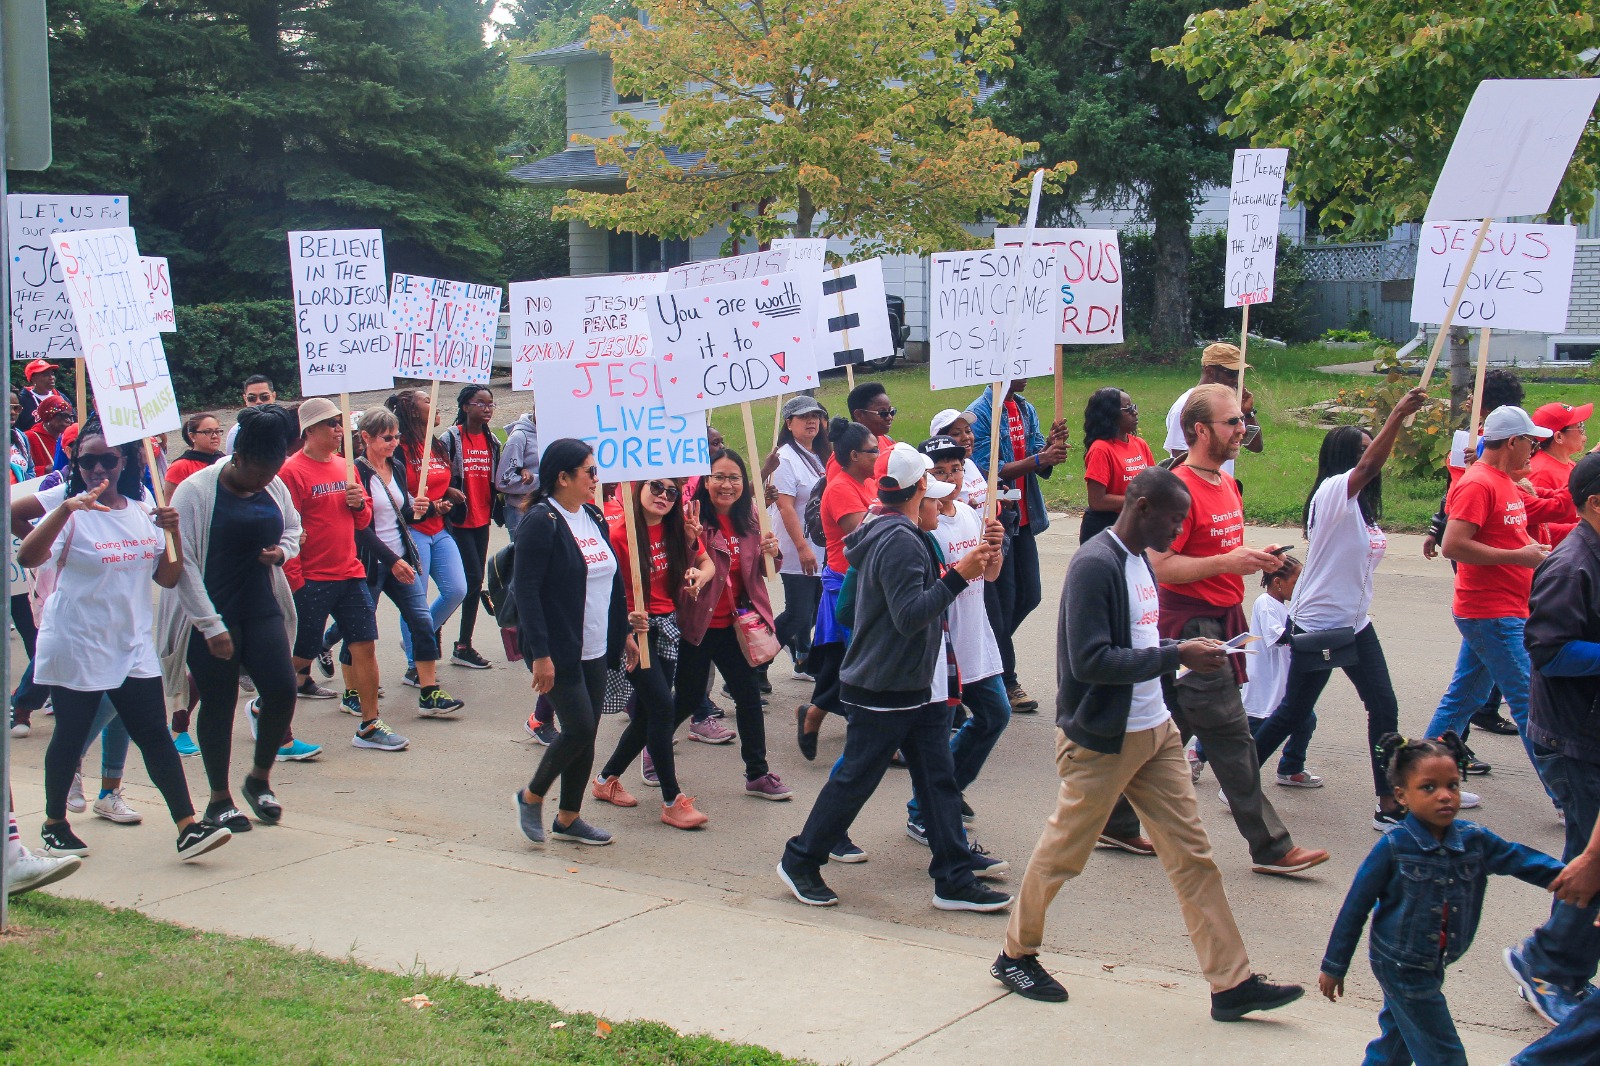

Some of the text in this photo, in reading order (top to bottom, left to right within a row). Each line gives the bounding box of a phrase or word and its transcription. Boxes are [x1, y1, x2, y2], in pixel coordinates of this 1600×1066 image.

[1236, 154, 1252, 184] I
[20, 201, 59, 219] LET
[70, 206, 94, 218] US
[1243, 214, 1260, 232] TO
[60, 234, 129, 275] SAVED
[300, 236, 380, 259] BELIEVE
[1231, 239, 1245, 255] THE
[1431, 226, 1551, 260] JESUS
[306, 261, 367, 281] IN THE
[938, 258, 974, 284] THE
[1033, 257, 1055, 278] OF
[14, 289, 45, 302] THE
[298, 285, 387, 306] LORD JESUS
[394, 275, 497, 301] BE THE LIGHT
[525, 296, 647, 315] NO JESUS
[657, 282, 801, 342] You are worth
[940, 282, 985, 320] MAN
[89, 301, 155, 340] AMAZING
[324, 314, 338, 334] U
[347, 311, 388, 330] SHALL
[426, 298, 458, 333] IN
[525, 314, 628, 336] NO PEACE
[29, 324, 51, 333] OF
[306, 335, 390, 359] BE SAVED
[394, 333, 492, 371] THE WORLD
[516, 333, 648, 363] KNOW JESUS
[699, 328, 752, 359] it to
[936, 331, 962, 351] TO
[91, 337, 169, 390] GRACE
[308, 364, 325, 374] Act
[947, 358, 984, 380] THE
[572, 362, 663, 398] JESU
[108, 405, 139, 428] LOVE
[142, 386, 175, 424] PRAISE
[95, 541, 121, 551] Going
[122, 539, 139, 548] the
[101, 554, 121, 563] mile
[123, 552, 138, 561] for
[584, 551, 608, 565] esus
